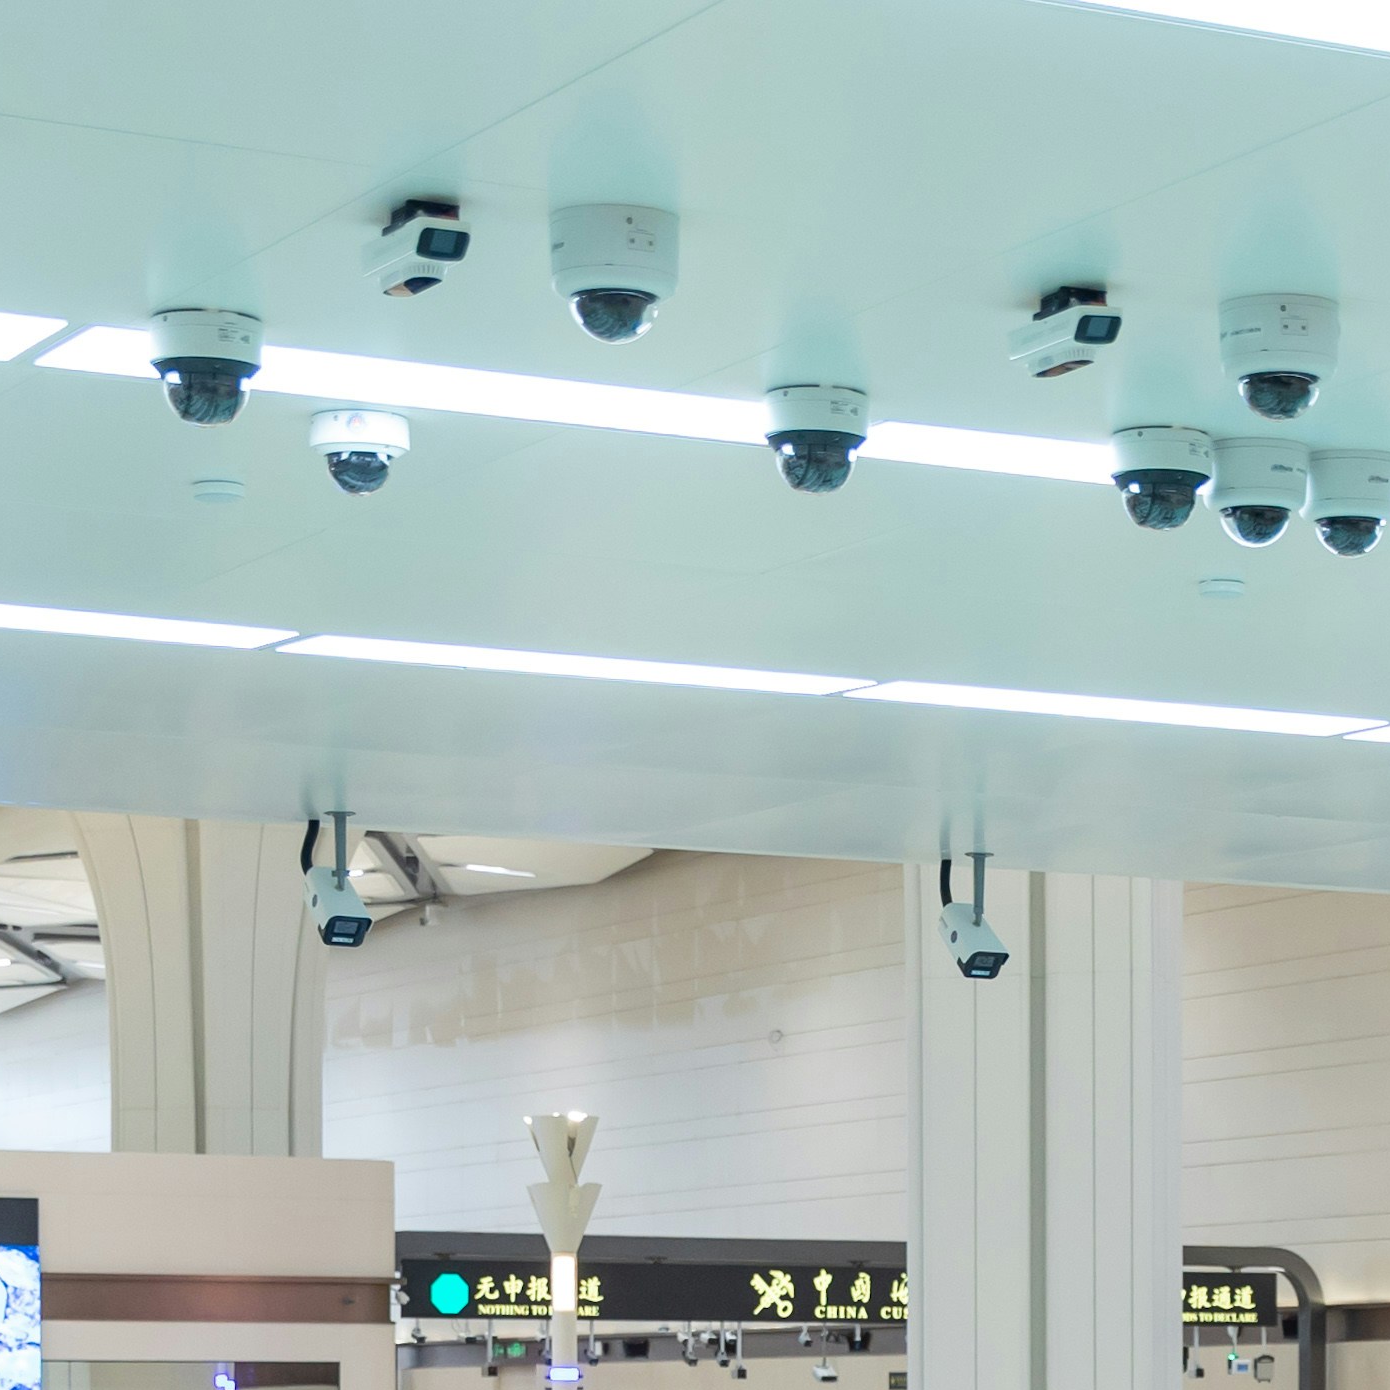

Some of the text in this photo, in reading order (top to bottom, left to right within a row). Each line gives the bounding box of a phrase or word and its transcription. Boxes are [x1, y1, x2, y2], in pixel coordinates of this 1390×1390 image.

[474, 1274, 604, 1303] 无申报道
[1181, 1285, 1256, 1309] 报通道
[477, 1304, 529, 1316] NOTHING
[530, 1304, 547, 1316] TO
[814, 1305, 869, 1319] CHINA
